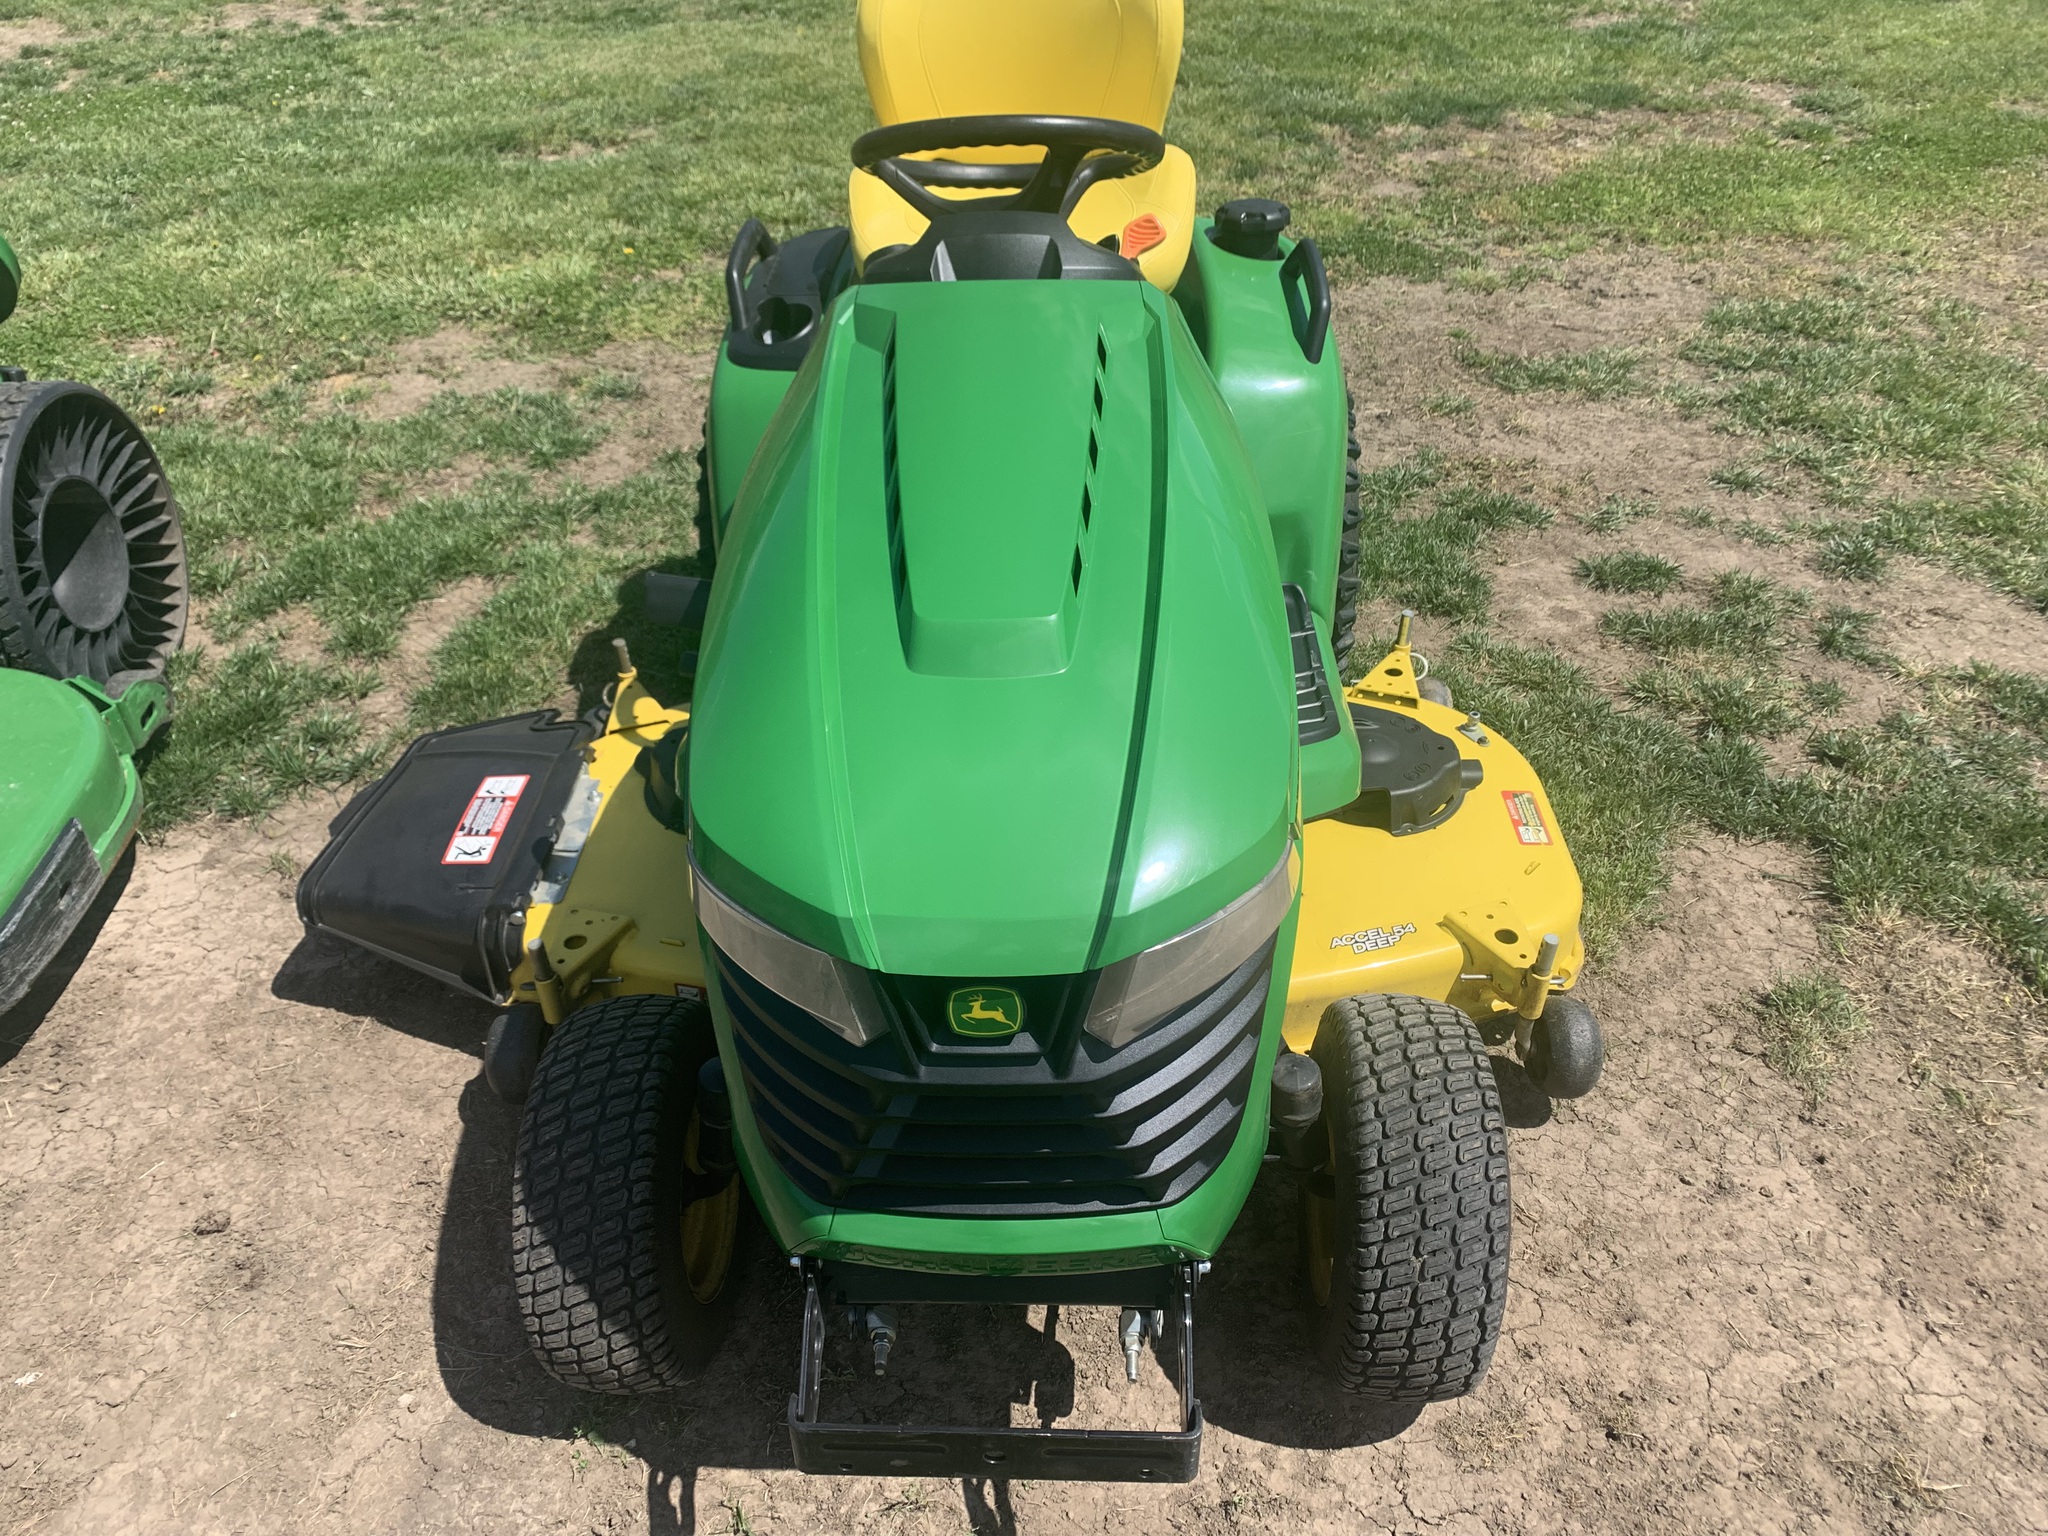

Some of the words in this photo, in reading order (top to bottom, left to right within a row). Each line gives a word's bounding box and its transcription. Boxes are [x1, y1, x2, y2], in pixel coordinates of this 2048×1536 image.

[1330, 927, 1391, 949] ACCEL
[1391, 922, 1417, 937] 54
[1352, 934, 1402, 954] DEEP
